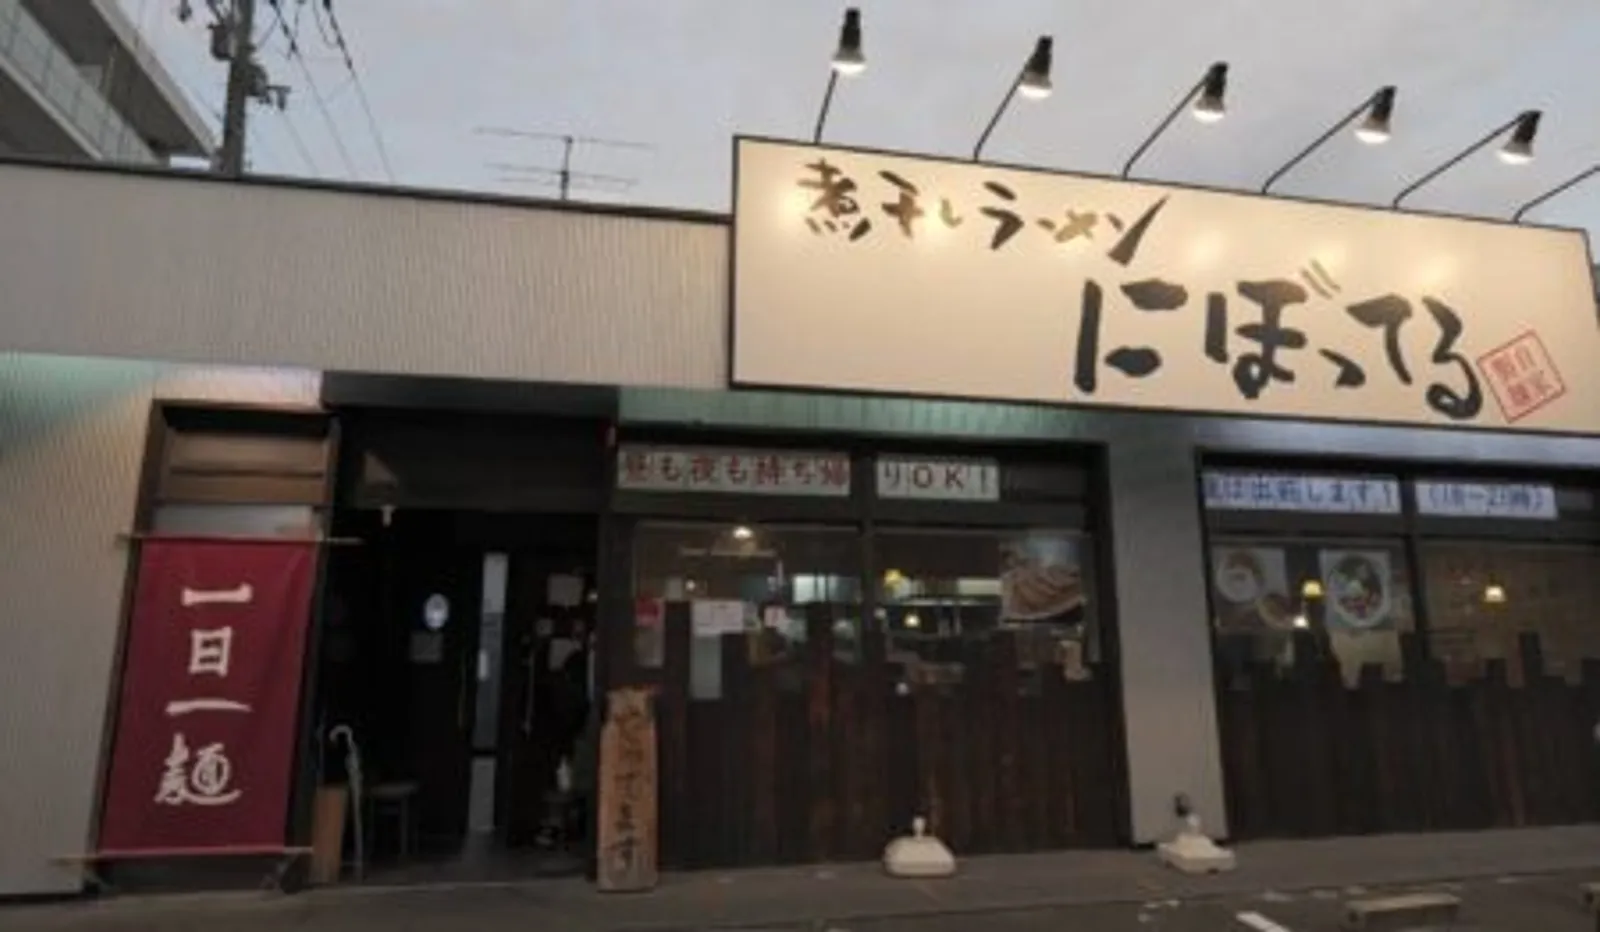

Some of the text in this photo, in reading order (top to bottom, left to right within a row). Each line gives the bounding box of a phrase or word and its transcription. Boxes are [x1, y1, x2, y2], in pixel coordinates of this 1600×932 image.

[797, 158, 1170, 266] 煮干しラーメン
[1074, 259, 1481, 417] にぼってる
